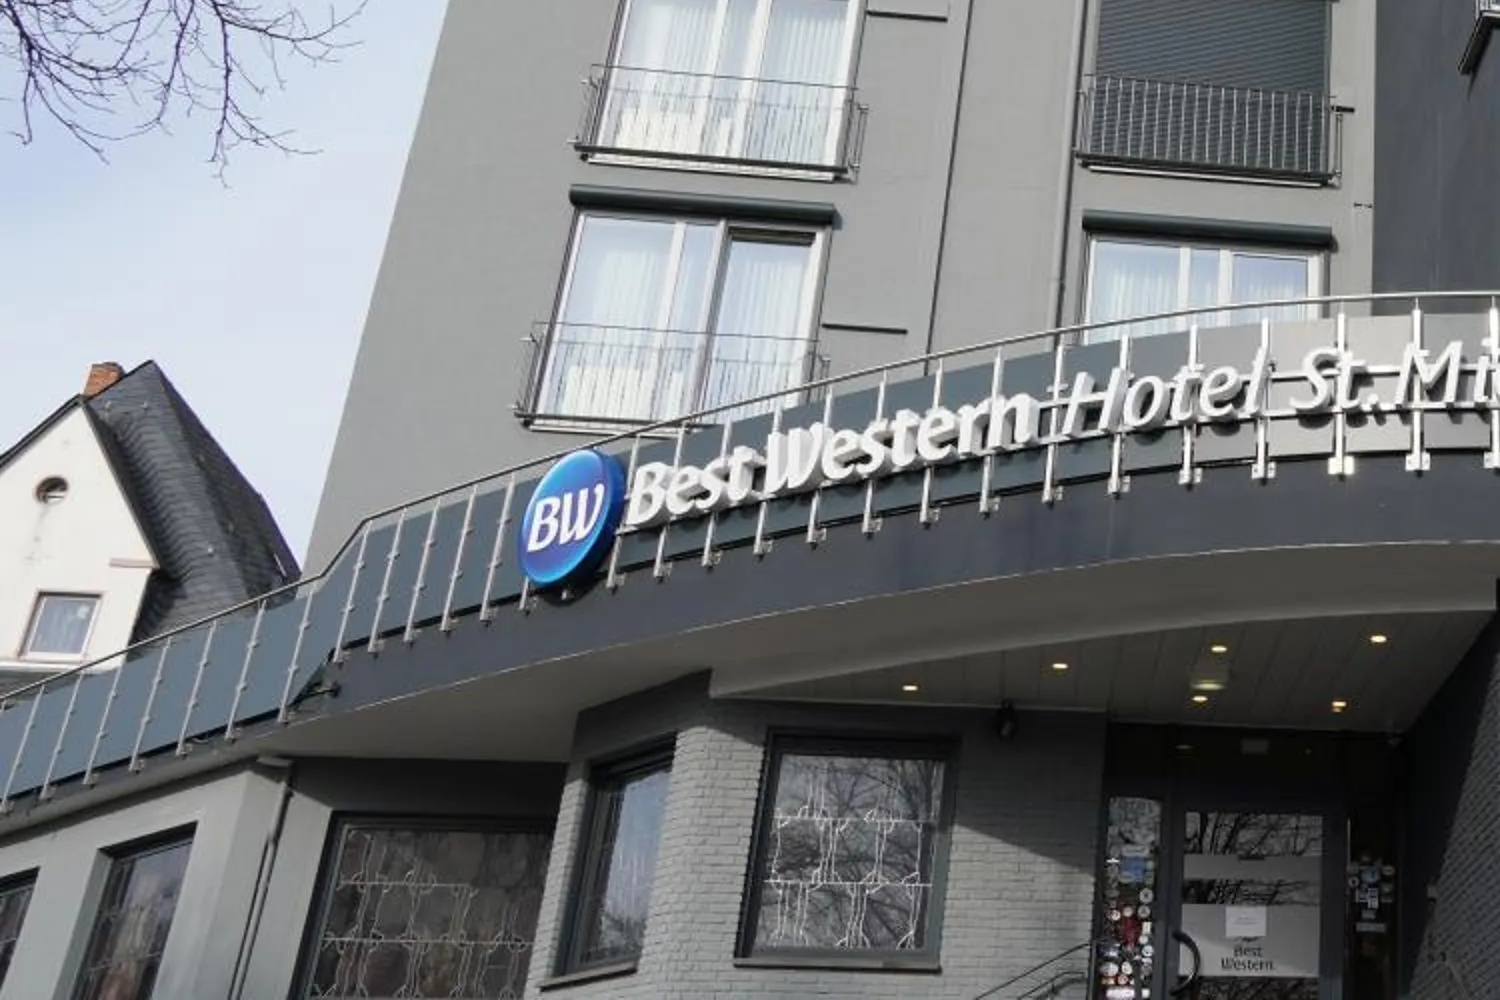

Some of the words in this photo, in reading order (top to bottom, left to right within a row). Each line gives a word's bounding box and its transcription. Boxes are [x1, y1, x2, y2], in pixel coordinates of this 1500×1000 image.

[627, 446, 764, 527] Best
[766, 393, 1039, 496] Western
[1061, 344, 1270, 435] Hotel
[526, 483, 605, 553] BW
[1221, 957, 1274, 970] Western
